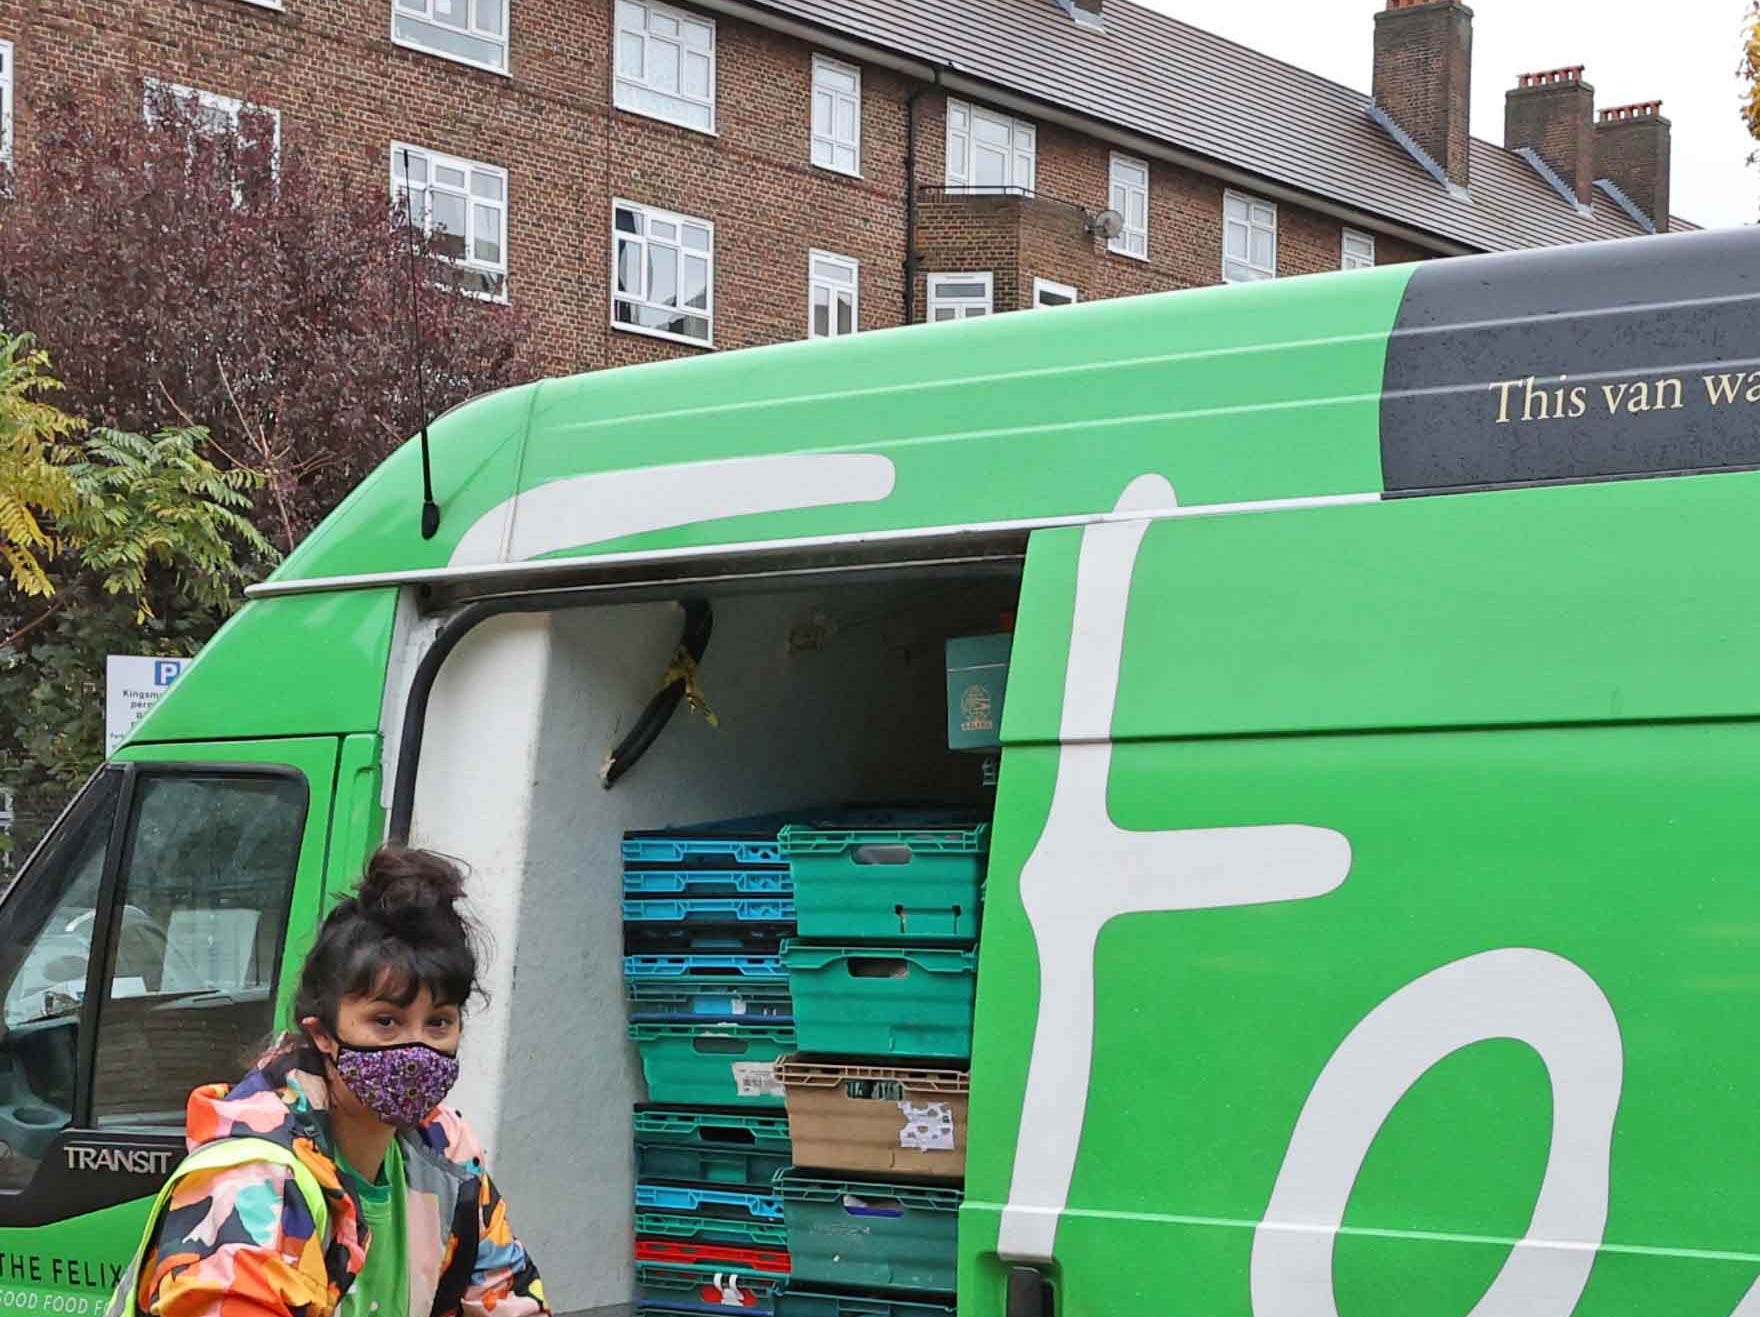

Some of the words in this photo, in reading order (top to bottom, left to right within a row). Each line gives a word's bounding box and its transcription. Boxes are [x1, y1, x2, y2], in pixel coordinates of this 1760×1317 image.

[1489, 374, 1587, 423] This
[1601, 377, 1683, 415] van
[63, 1145, 173, 1175] TRANSIT
[52, 1257, 123, 1289] FELIX
[43, 1294, 88, 1315] FOOD
